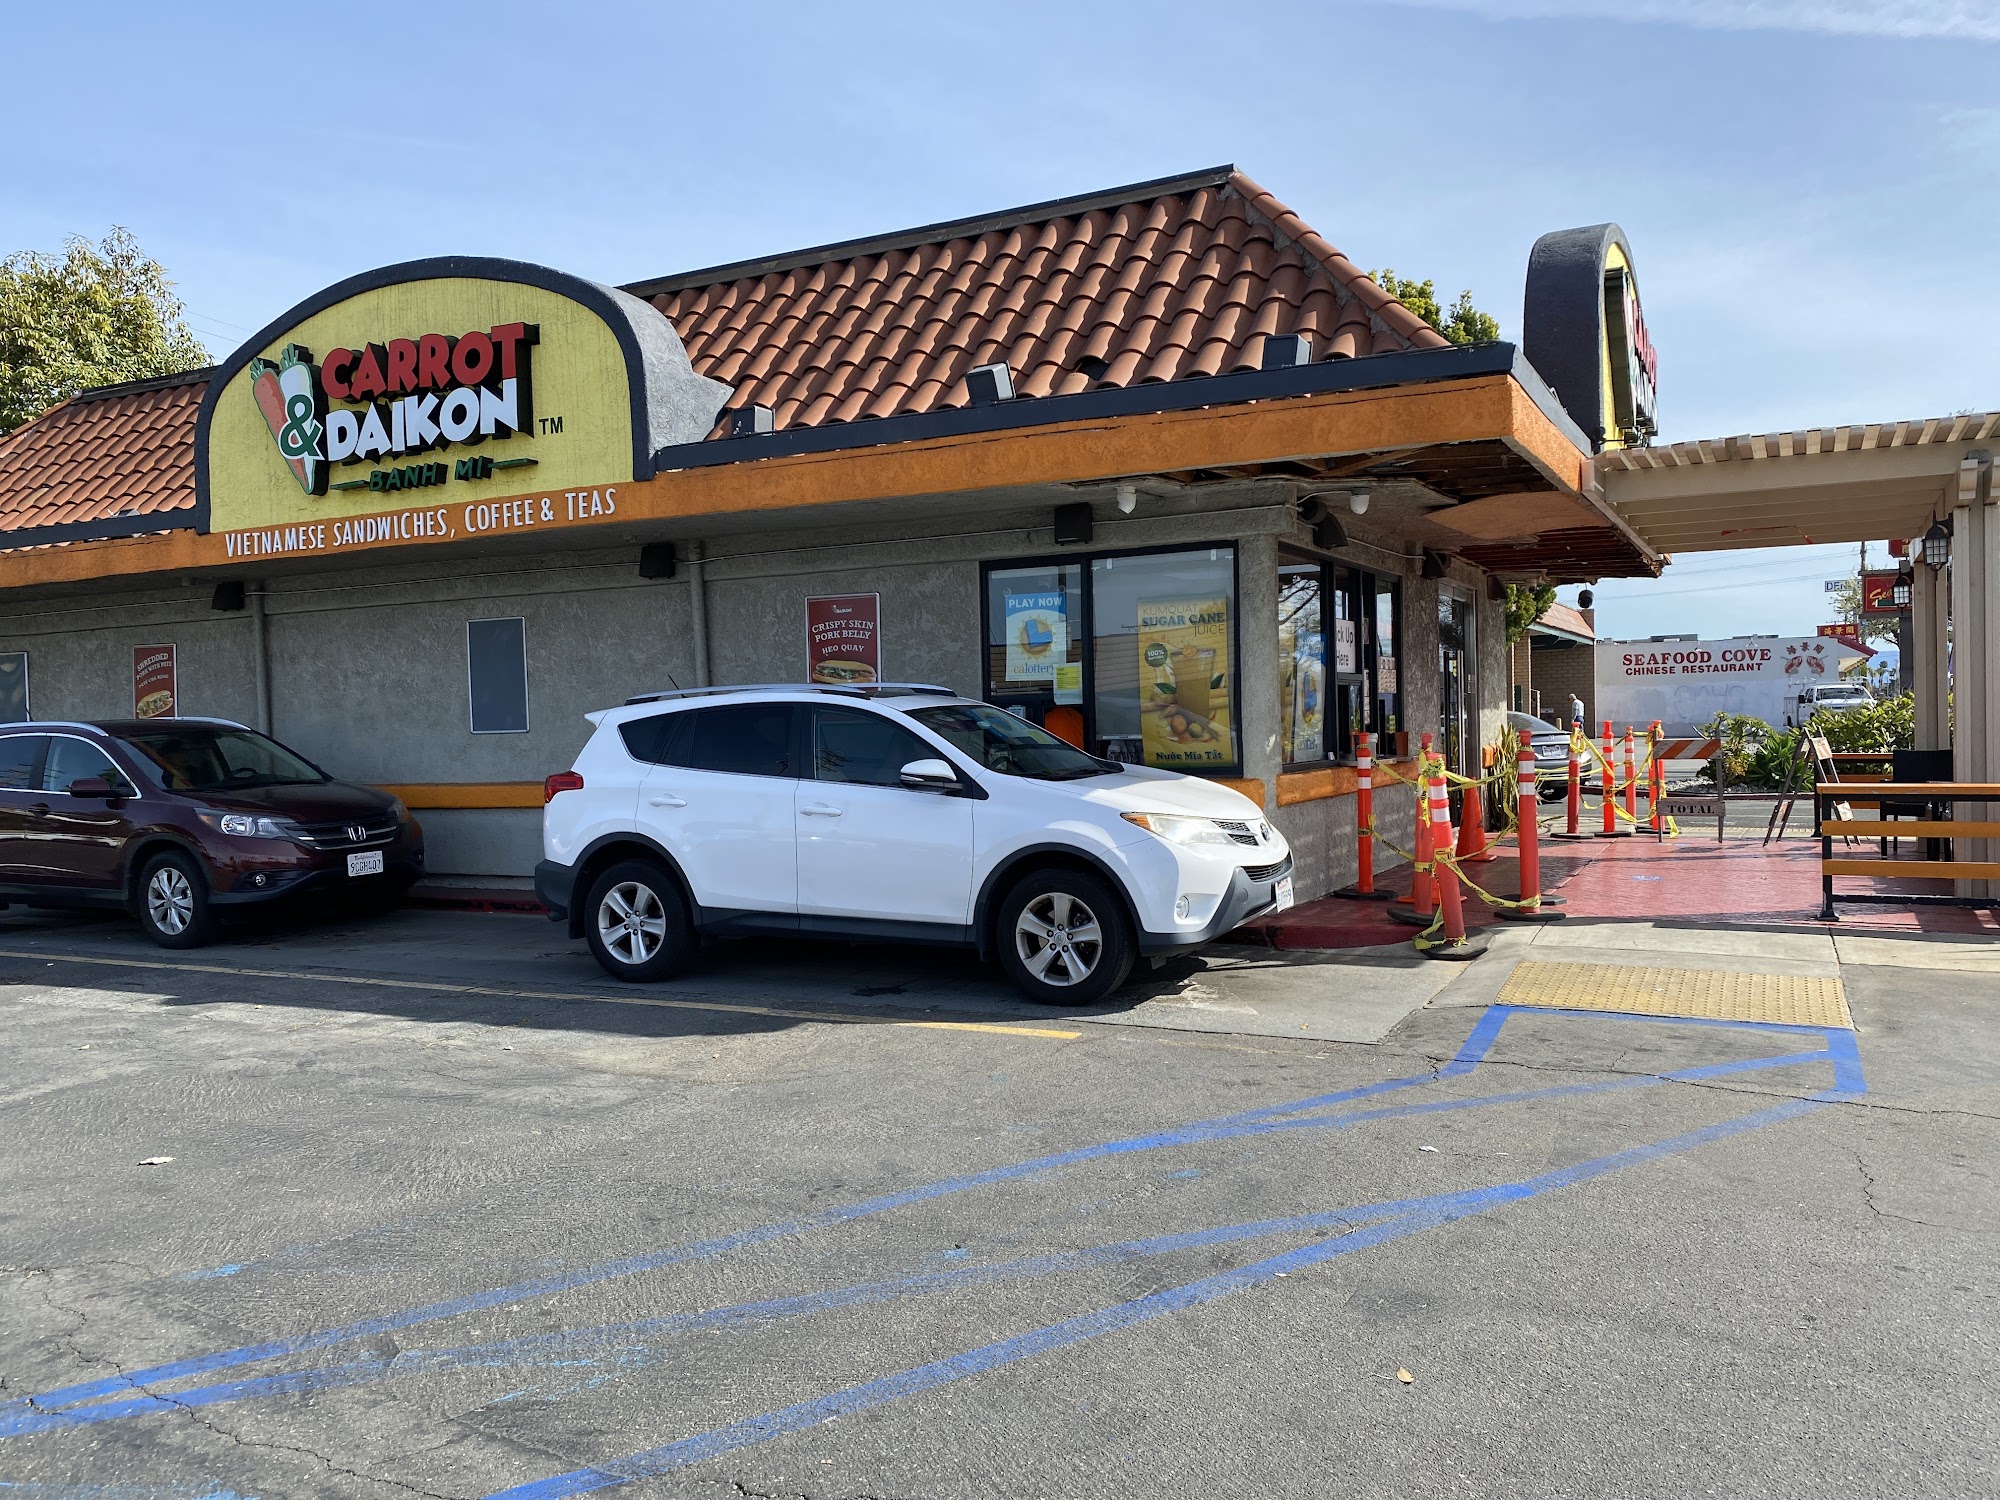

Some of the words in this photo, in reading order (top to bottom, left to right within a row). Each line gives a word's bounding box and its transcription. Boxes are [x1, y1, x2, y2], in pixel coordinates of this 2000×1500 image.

[321, 322, 530, 399] CARROT
[278, 394, 324, 460] &
[326, 378, 521, 462] DAIKON
[539, 416, 564, 435] TM
[369, 462, 442, 493] BANH
[455, 456, 486, 481] MI
[225, 525, 326, 558] VIETNAMESE
[333, 508, 455, 548] SANDWICHES,
[465, 499, 534, 533] COFFEE
[541, 497, 554, 522] &
[565, 488, 617, 521] TEAS
[1008, 598, 1035, 608] PLAY
[1038, 596, 1063, 607] NOW
[1143, 603, 1199, 616] KUMQUAT
[812, 620, 847, 633] CRISPY
[849, 620, 874, 630] SKIN
[1141, 614, 1186, 627] SUGAR
[1188, 612, 1226, 625] CANE
[815, 630, 840, 643] PORK
[842, 630, 871, 639] BELLY
[1193, 624, 1226, 637] JUICE
[1345, 626, 1354, 648] Up
[137, 653, 168, 670] SHREDDED
[1622, 650, 1712, 666] SEAFOOD
[1722, 648, 1772, 662] COVE
[1625, 666, 1676, 676] CHINESE
[1682, 663, 1763, 674] RESTAURANT
[1667, 804, 1715, 814] TOTAL
